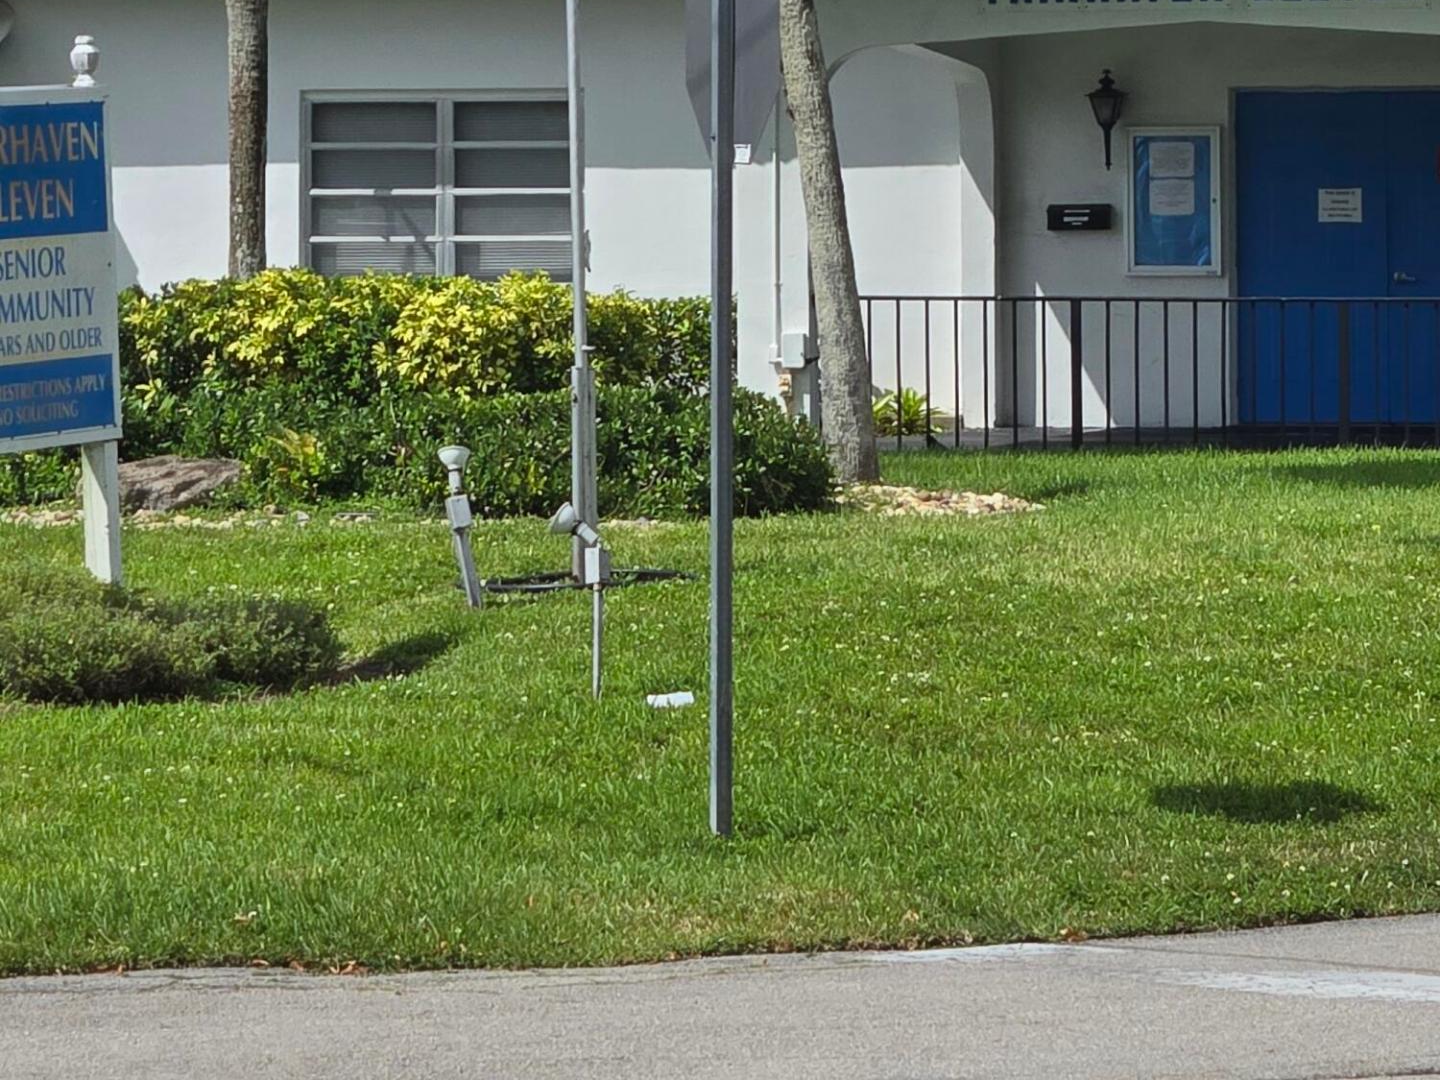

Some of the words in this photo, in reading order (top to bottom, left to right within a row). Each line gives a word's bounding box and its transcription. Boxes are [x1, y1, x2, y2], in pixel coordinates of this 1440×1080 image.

[25, 331, 56, 356] AND
[60, 327, 103, 351] OLDER
[74, 373, 106, 394] APPLY
